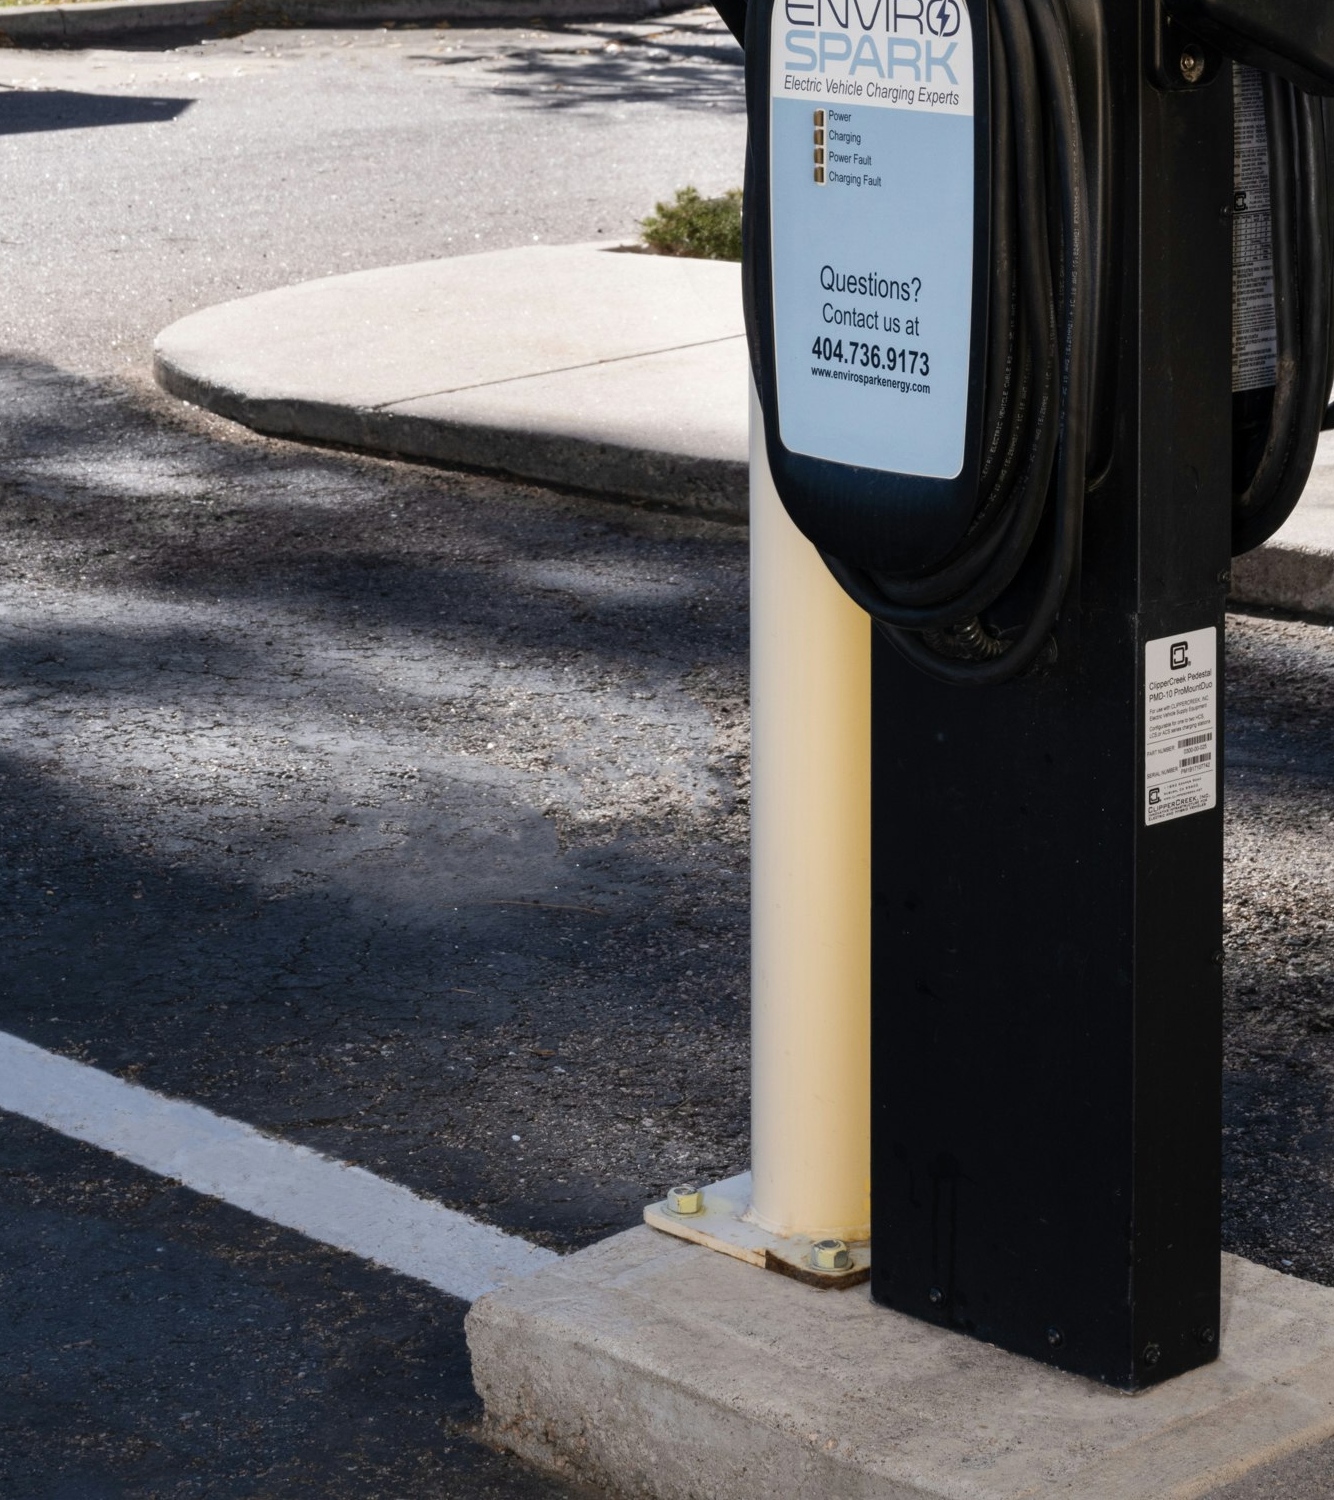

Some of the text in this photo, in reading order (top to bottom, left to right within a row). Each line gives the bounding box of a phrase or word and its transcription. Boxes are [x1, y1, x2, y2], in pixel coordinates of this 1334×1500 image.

[785, 30, 959, 84] SPARK
[785, 75, 959, 106] Electric Vehicle Charging Experts
[829, 110, 851, 122] Power
[829, 130, 861, 145] Charging
[829, 152, 871, 166] Power Fault
[829, 171, 881, 187] Charging Fault
[820, 265, 921, 302] Questions?
[823, 303, 919, 336] Contact us at
[811, 336, 929, 376] 404.736.9173
[811, 367, 930, 394] www.envirosparkenergy.com
[1149, 669, 1211, 690] ClipperCreek Pedestal
[1149, 682, 1212, 702] PMD-10 ProMountDuo
